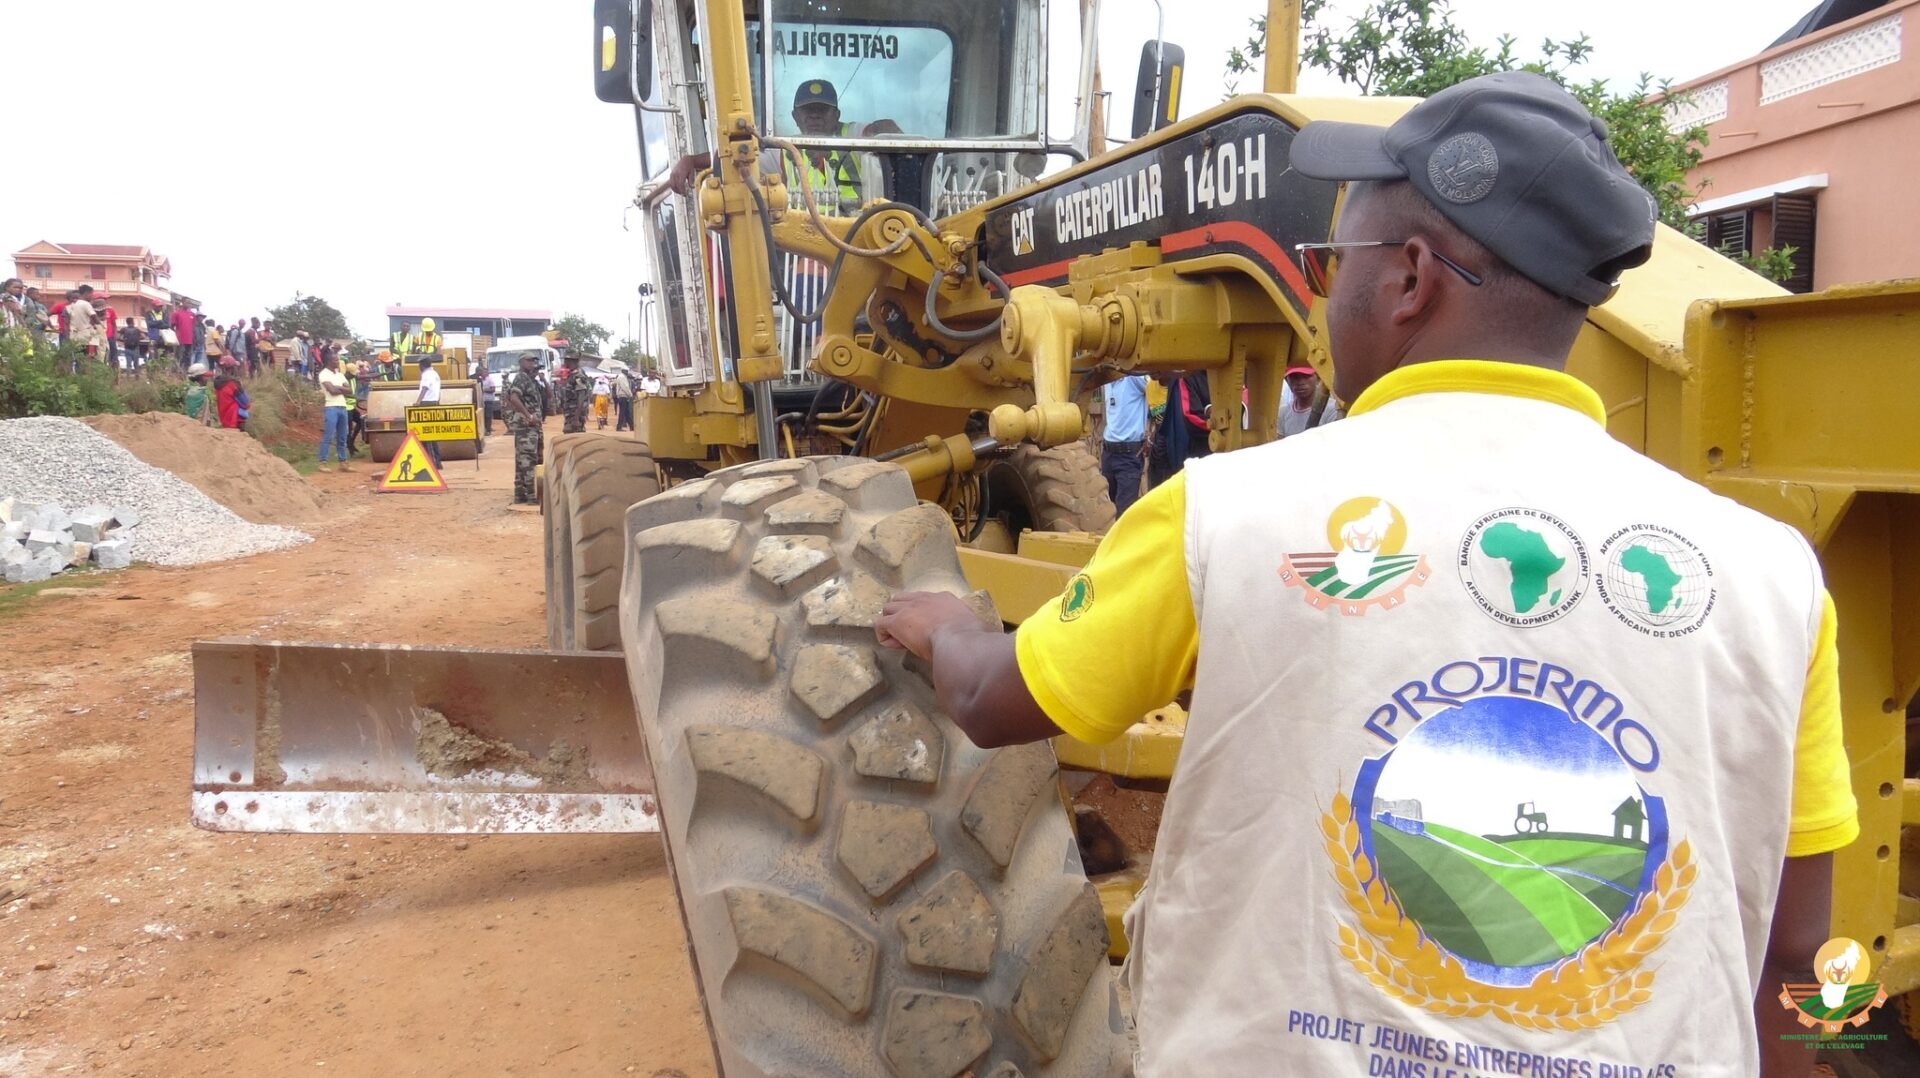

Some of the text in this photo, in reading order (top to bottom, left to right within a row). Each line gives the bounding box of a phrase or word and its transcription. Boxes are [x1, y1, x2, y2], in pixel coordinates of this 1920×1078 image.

[1011, 134, 1267, 256] CAT CATERPILLAR 140-H
[410, 408, 471, 422] ATTENTION TRAVAUX
[440, 424, 461, 433] CHANTIER
[1460, 529, 1477, 567] BANQUE
[1474, 509, 1521, 530] AFRICAINE
[1539, 513, 1588, 578] DEVELOPPEMENT
[1600, 523, 1713, 577] AFRICAN DEVELOPMENT FUND
[1465, 581, 1582, 625] AFRICAN DEVELOPMENT BANK
[1595, 573, 1611, 604] FONDS
[1608, 605, 1651, 635] AFRICAIN
[1653, 630, 1666, 638] DE
[1363, 656, 1660, 773] PROJERMO
[1288, 1010, 1365, 1045] PROJET
[1369, 1026, 1449, 1063] JEUNES
[1455, 1042, 1592, 1078] ENTREPRISES
[1369, 1053, 1427, 1078] DANS
